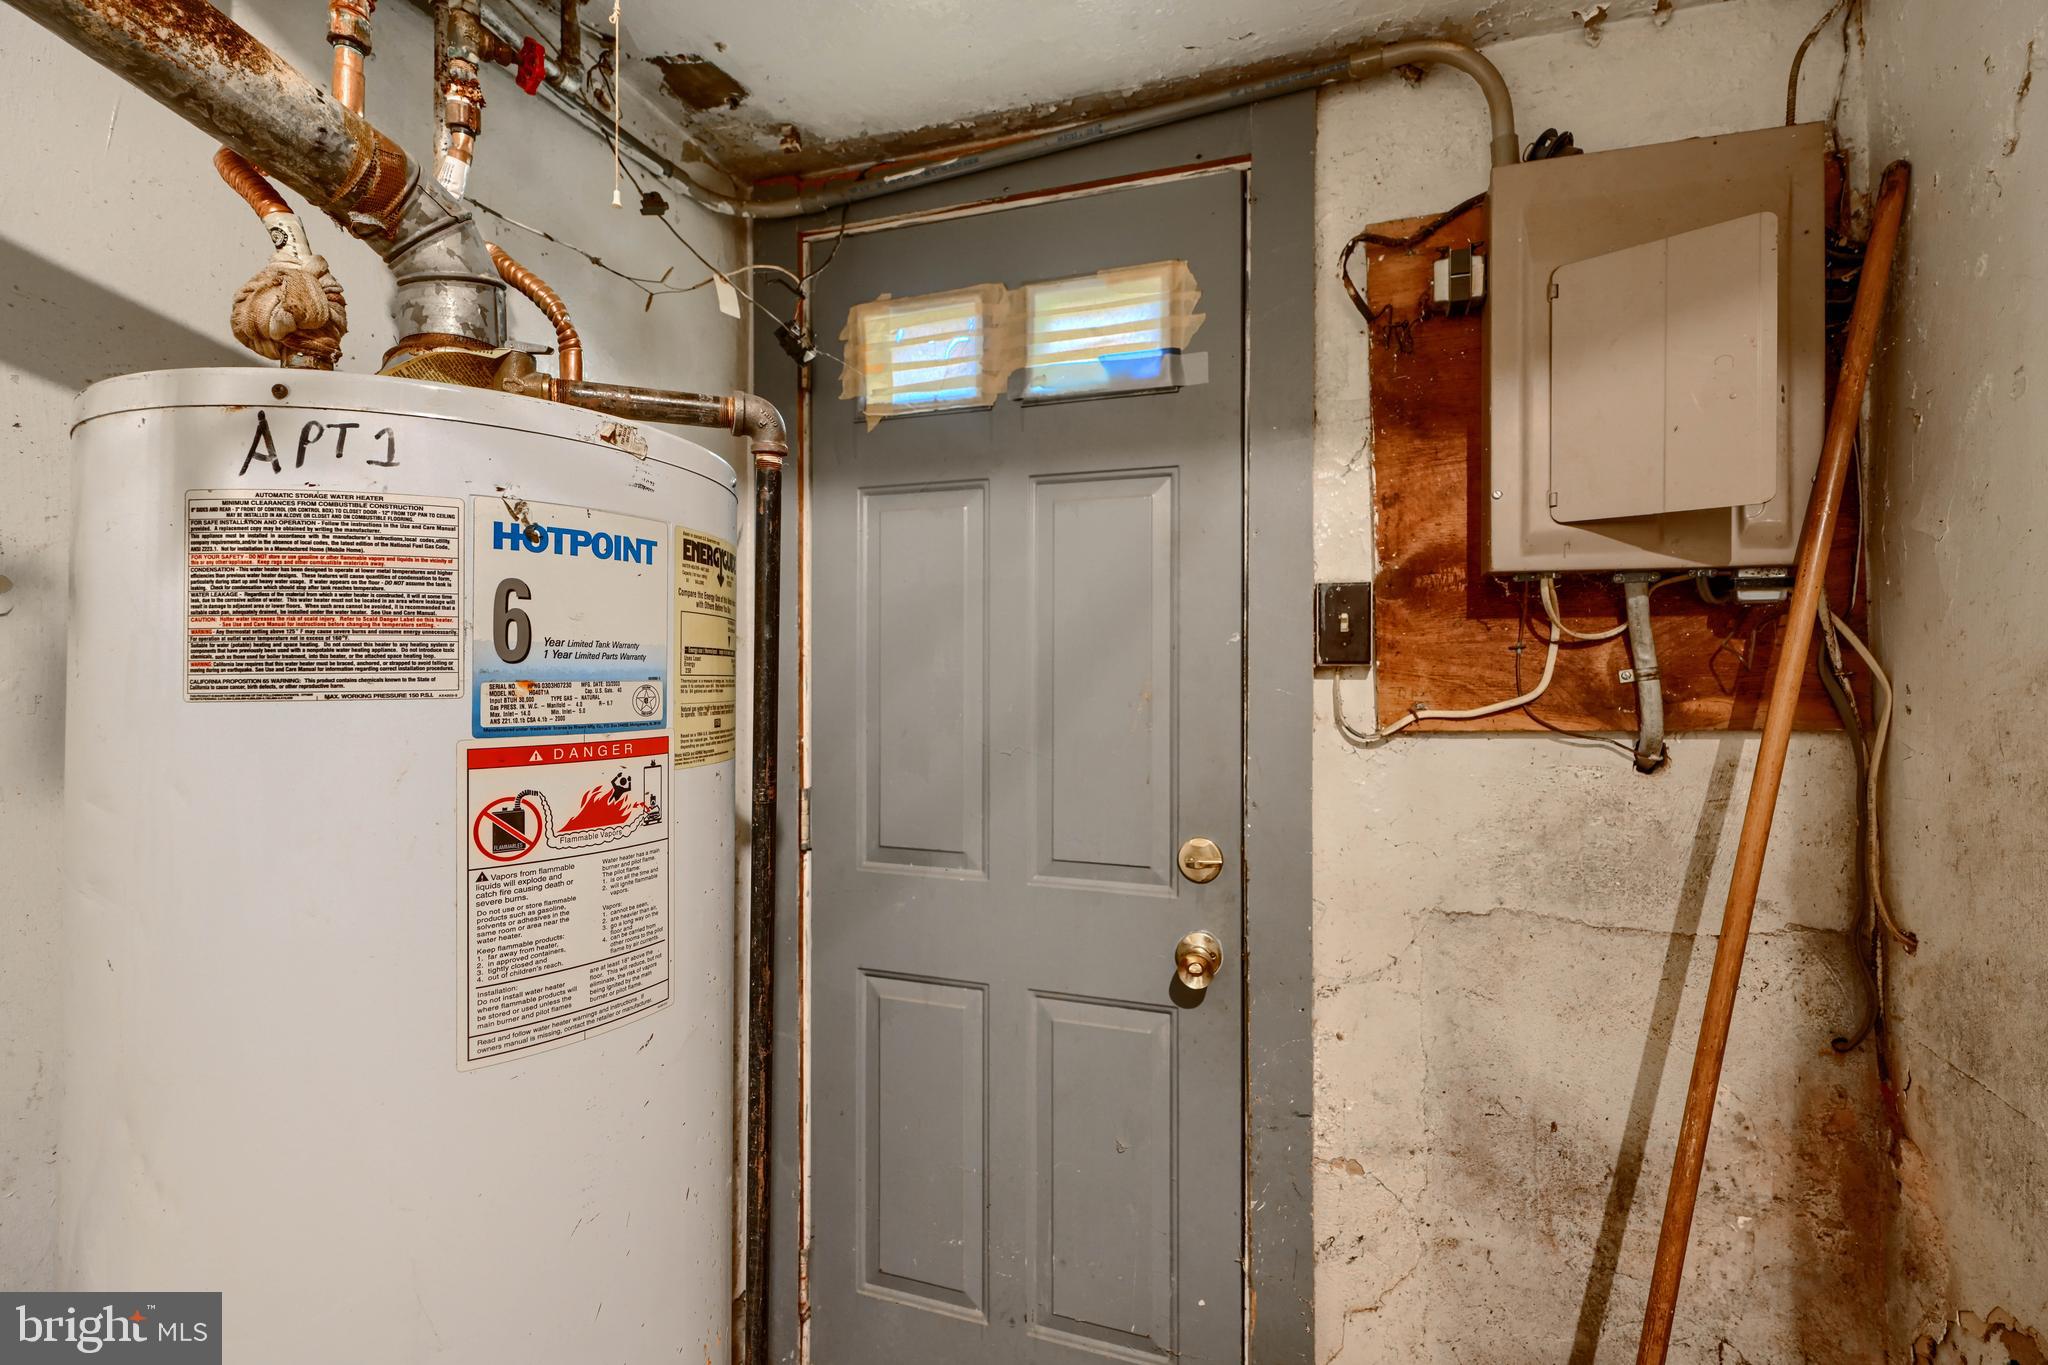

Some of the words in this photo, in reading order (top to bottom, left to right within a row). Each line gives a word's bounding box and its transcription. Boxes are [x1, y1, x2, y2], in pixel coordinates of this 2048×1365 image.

[367, 428, 400, 467] 1
[369, 503, 424, 511] CONSTRUCTION
[493, 521, 657, 565] HOTPOINT
[704, 592, 714, 602] Energy
[493, 578, 532, 664] 6
[544, 637, 565, 647] Year
[568, 640, 593, 648] Limited
[595, 640, 610, 649] Tank
[612, 641, 640, 650] Warranty
[544, 650, 547, 658] 1
[553, 650, 572, 659] Year
[575, 652, 600, 660] Limited
[602, 652, 618, 660] Parts
[620, 653, 646, 662] Warranty
[554, 744, 633, 760] DANGER
[560, 833, 598, 844] Flammable
[600, 830, 622, 838] Vapors
[493, 843, 523, 851] FLAMMABLES
[491, 871, 518, 882] Vapors
[520, 868, 536, 876] from
[539, 864, 575, 874] flammable
[476, 881, 501, 892] liquids
[503, 879, 515, 887] will
[518, 875, 546, 886] explode
[549, 873, 562, 881] and
[476, 890, 497, 899] catch
[514, 883, 542, 894] causing
[545, 880, 564, 889] death
[476, 899, 502, 907] severe
[505, 894, 528, 903] burns.
[526, 901, 542, 909] store
[544, 895, 576, 906] flammable
[477, 913, 507, 924] products
[509, 910, 526, 918] such
[477, 920, 506, 930] solvents
[517, 913, 551, 924] adhesives
[477, 936, 497, 944] water
[498, 932, 522, 941] heater.
[498, 926, 516, 934] room
[477, 946, 495, 956] Keep
[498, 940, 533, 951] flammable
[535, 934, 564, 946] products:
[500, 950, 518, 958] away
[520, 946, 534, 954] from
[488, 964, 509, 975] tightly
[511, 960, 533, 969] closed
[535, 957, 547, 965] and
[496, 954, 528, 966] approved
[510, 964, 542, 976] children's
[544, 960, 563, 970] reach.
[477, 998, 487, 1006] Do
[503, 991, 523, 1000] install
[525, 986, 543, 996] water
[545, 982, 565, 992] heater
[477, 1003, 499, 1013] where
[501, 995, 536, 1008] flammable
[538, 989, 566, 1001] products
[567, 986, 577, 994] will
[478, 985, 518, 998] Installation:
[488, 1008, 510, 1019] stored
[521, 1002, 538, 1012] used
[539, 997, 560, 1008] unless
[562, 995, 572, 1003] the
[477, 1020, 494, 1029] main
[497, 1014, 520, 1025] burner
[521, 1011, 534, 1019] and
[536, 1008, 549, 1017] pilot
[551, 1003, 572, 1013] flames
